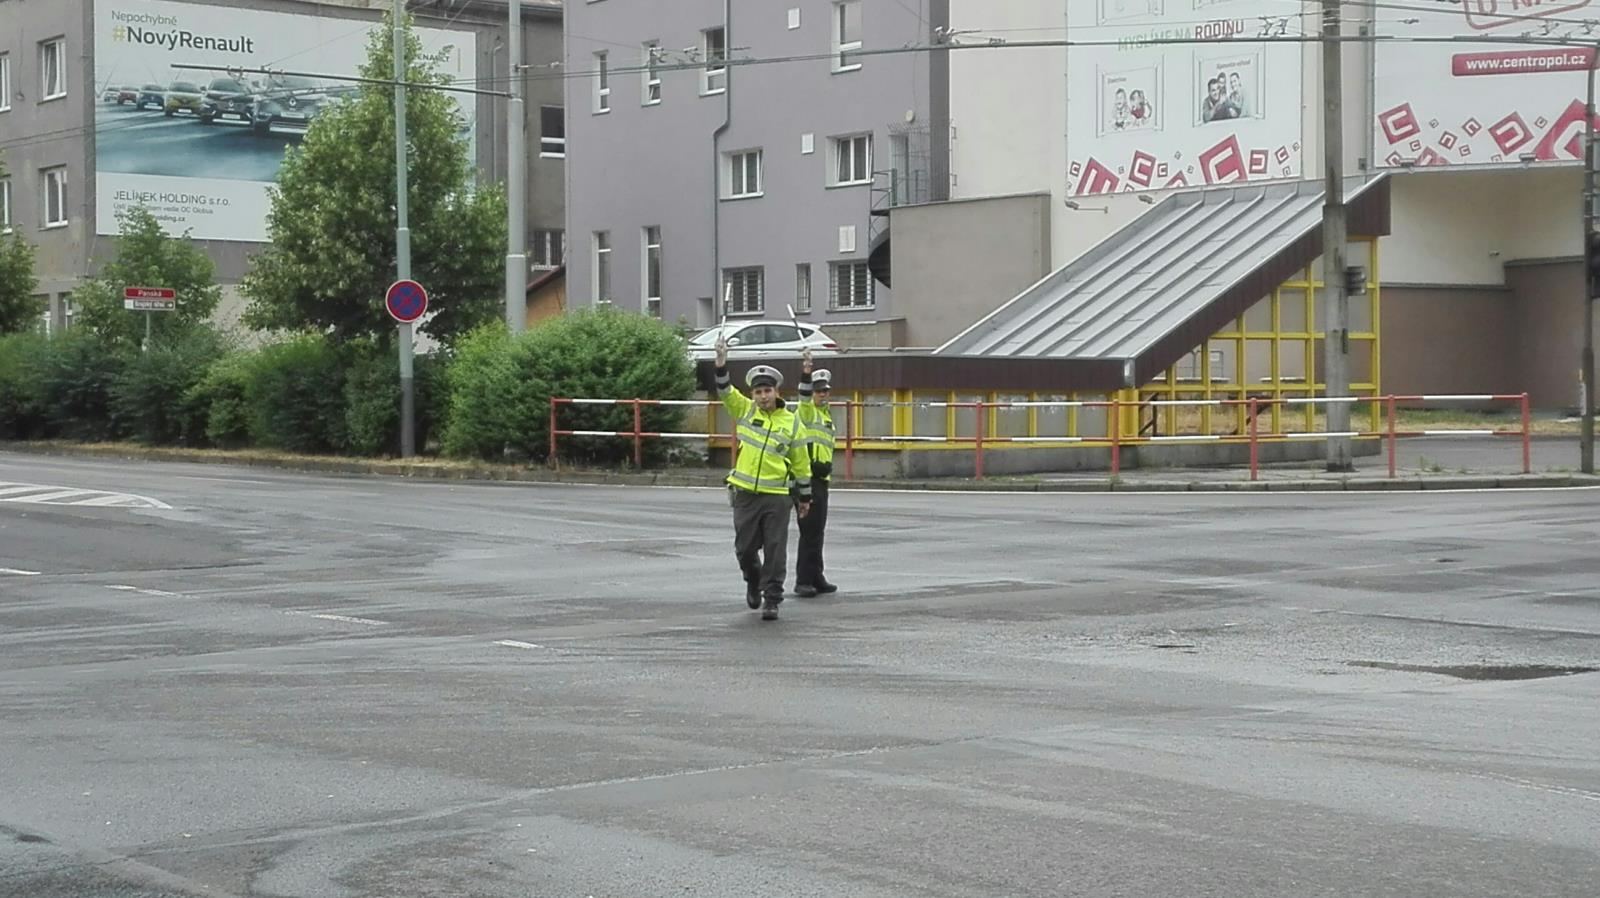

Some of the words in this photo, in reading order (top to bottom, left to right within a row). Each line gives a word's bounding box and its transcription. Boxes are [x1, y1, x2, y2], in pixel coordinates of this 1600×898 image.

[1194, 19, 1245, 40] RODINU
[112, 25, 254, 54] #NovýRenault
[1466, 53, 1586, 70] www.centropol.cz
[159, 192, 207, 206] HOLDING
